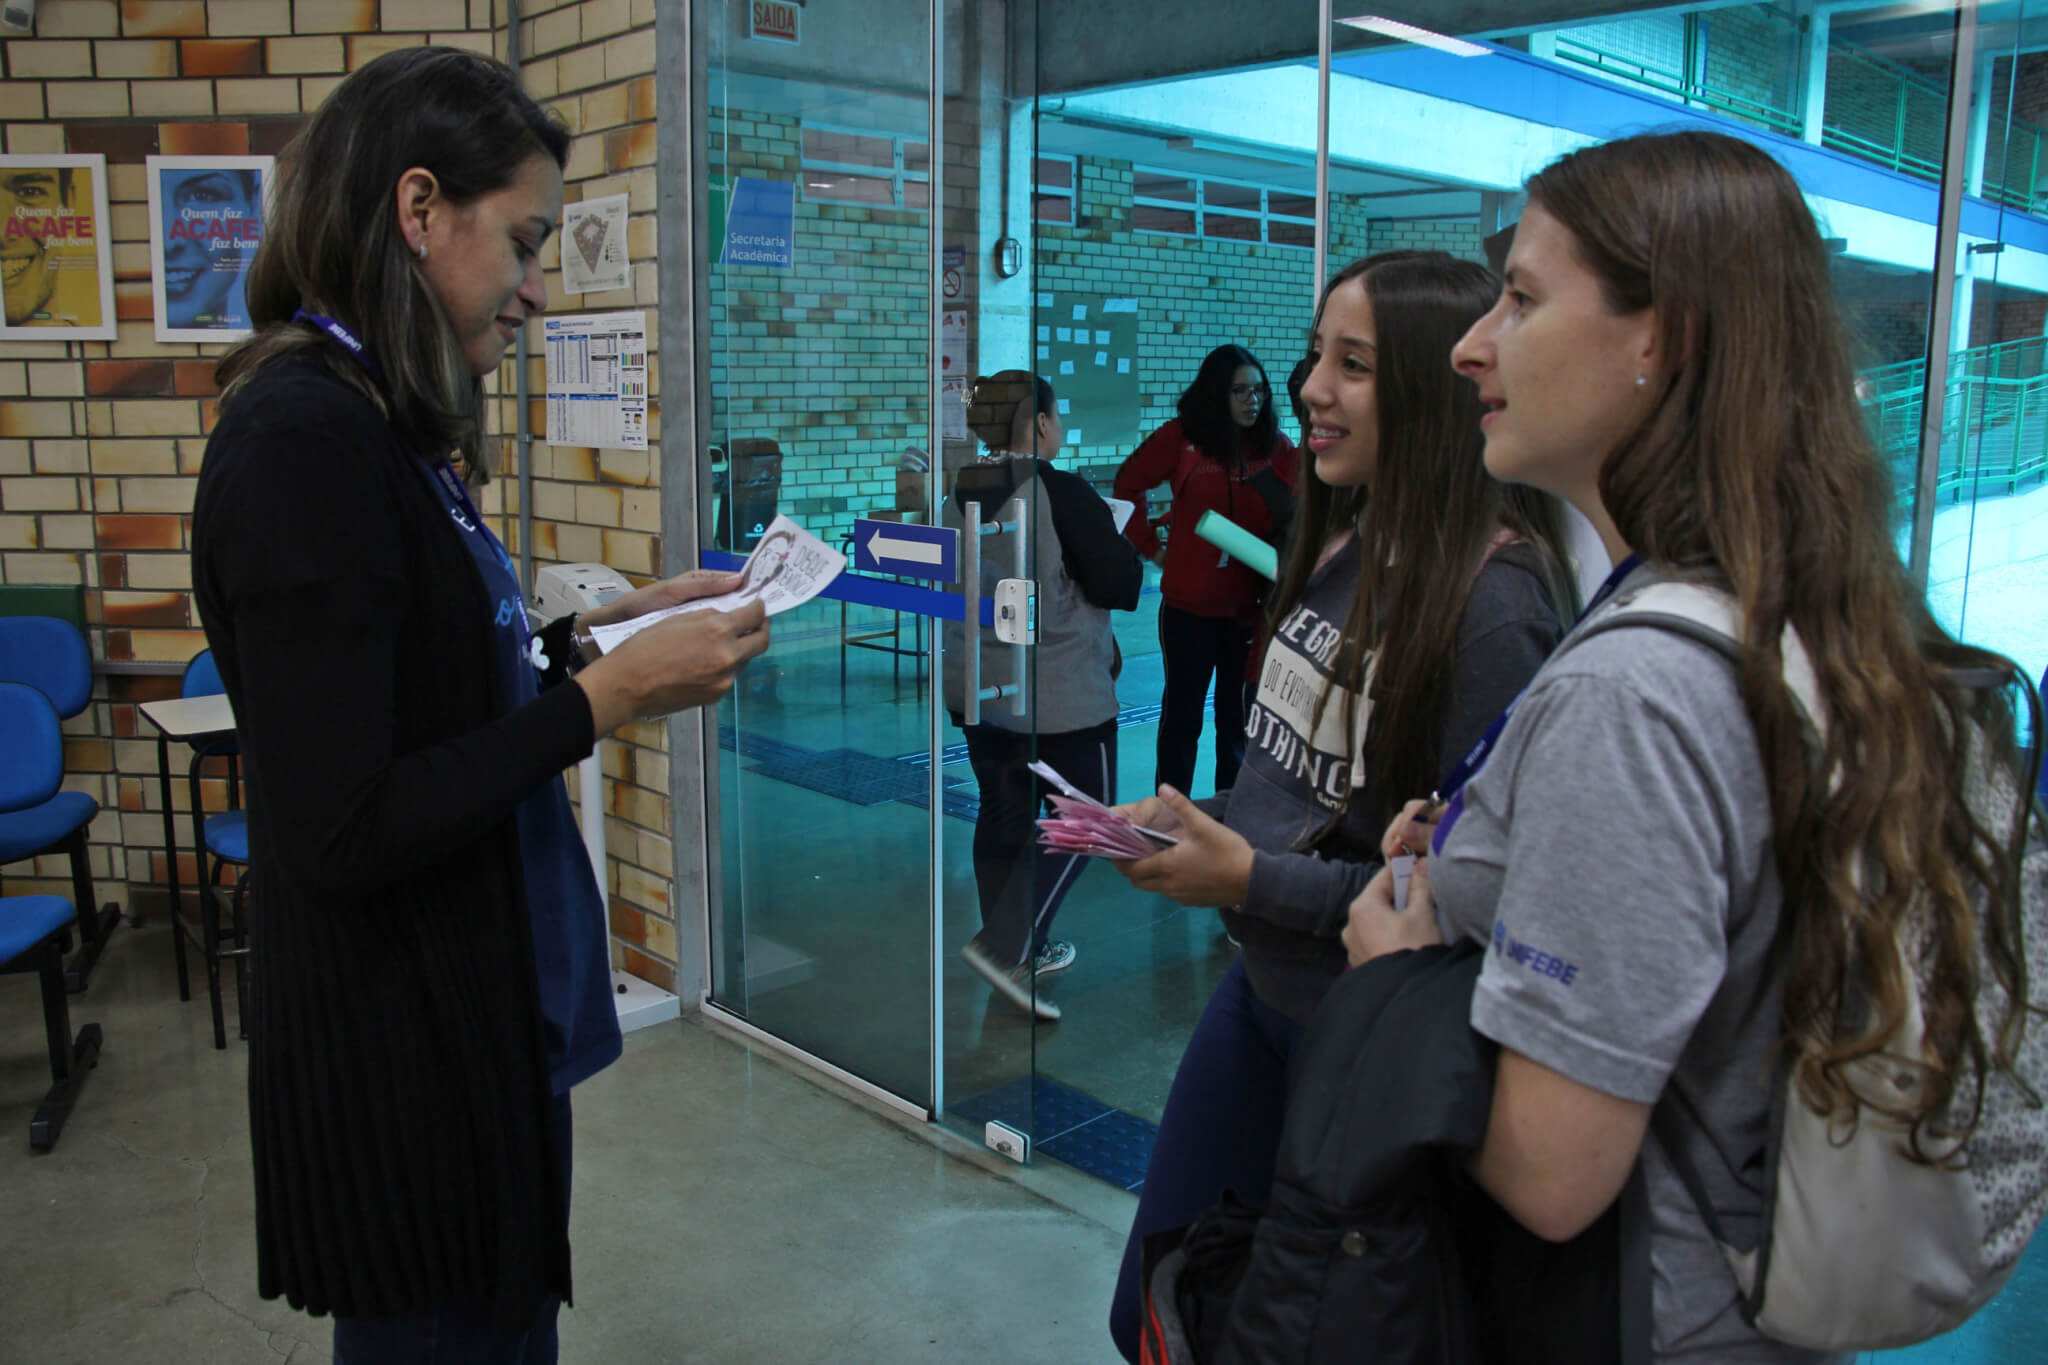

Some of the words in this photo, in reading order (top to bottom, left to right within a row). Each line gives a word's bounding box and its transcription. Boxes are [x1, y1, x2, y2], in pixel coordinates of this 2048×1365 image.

[15, 205, 52, 220] Quem
[52, 205, 75, 219] faz
[181, 207, 218, 222] Quem
[220, 207, 243, 221] faz
[4, 216, 93, 238] ACAFE
[168, 218, 260, 240] ACAFE
[43, 235, 64, 250] faz
[67, 235, 93, 247] bem
[208, 236, 232, 252] faz
[233, 236, 260, 249] bem
[730, 232, 786, 247] Secretaria
[1245, 703, 1350, 799] OTHING
